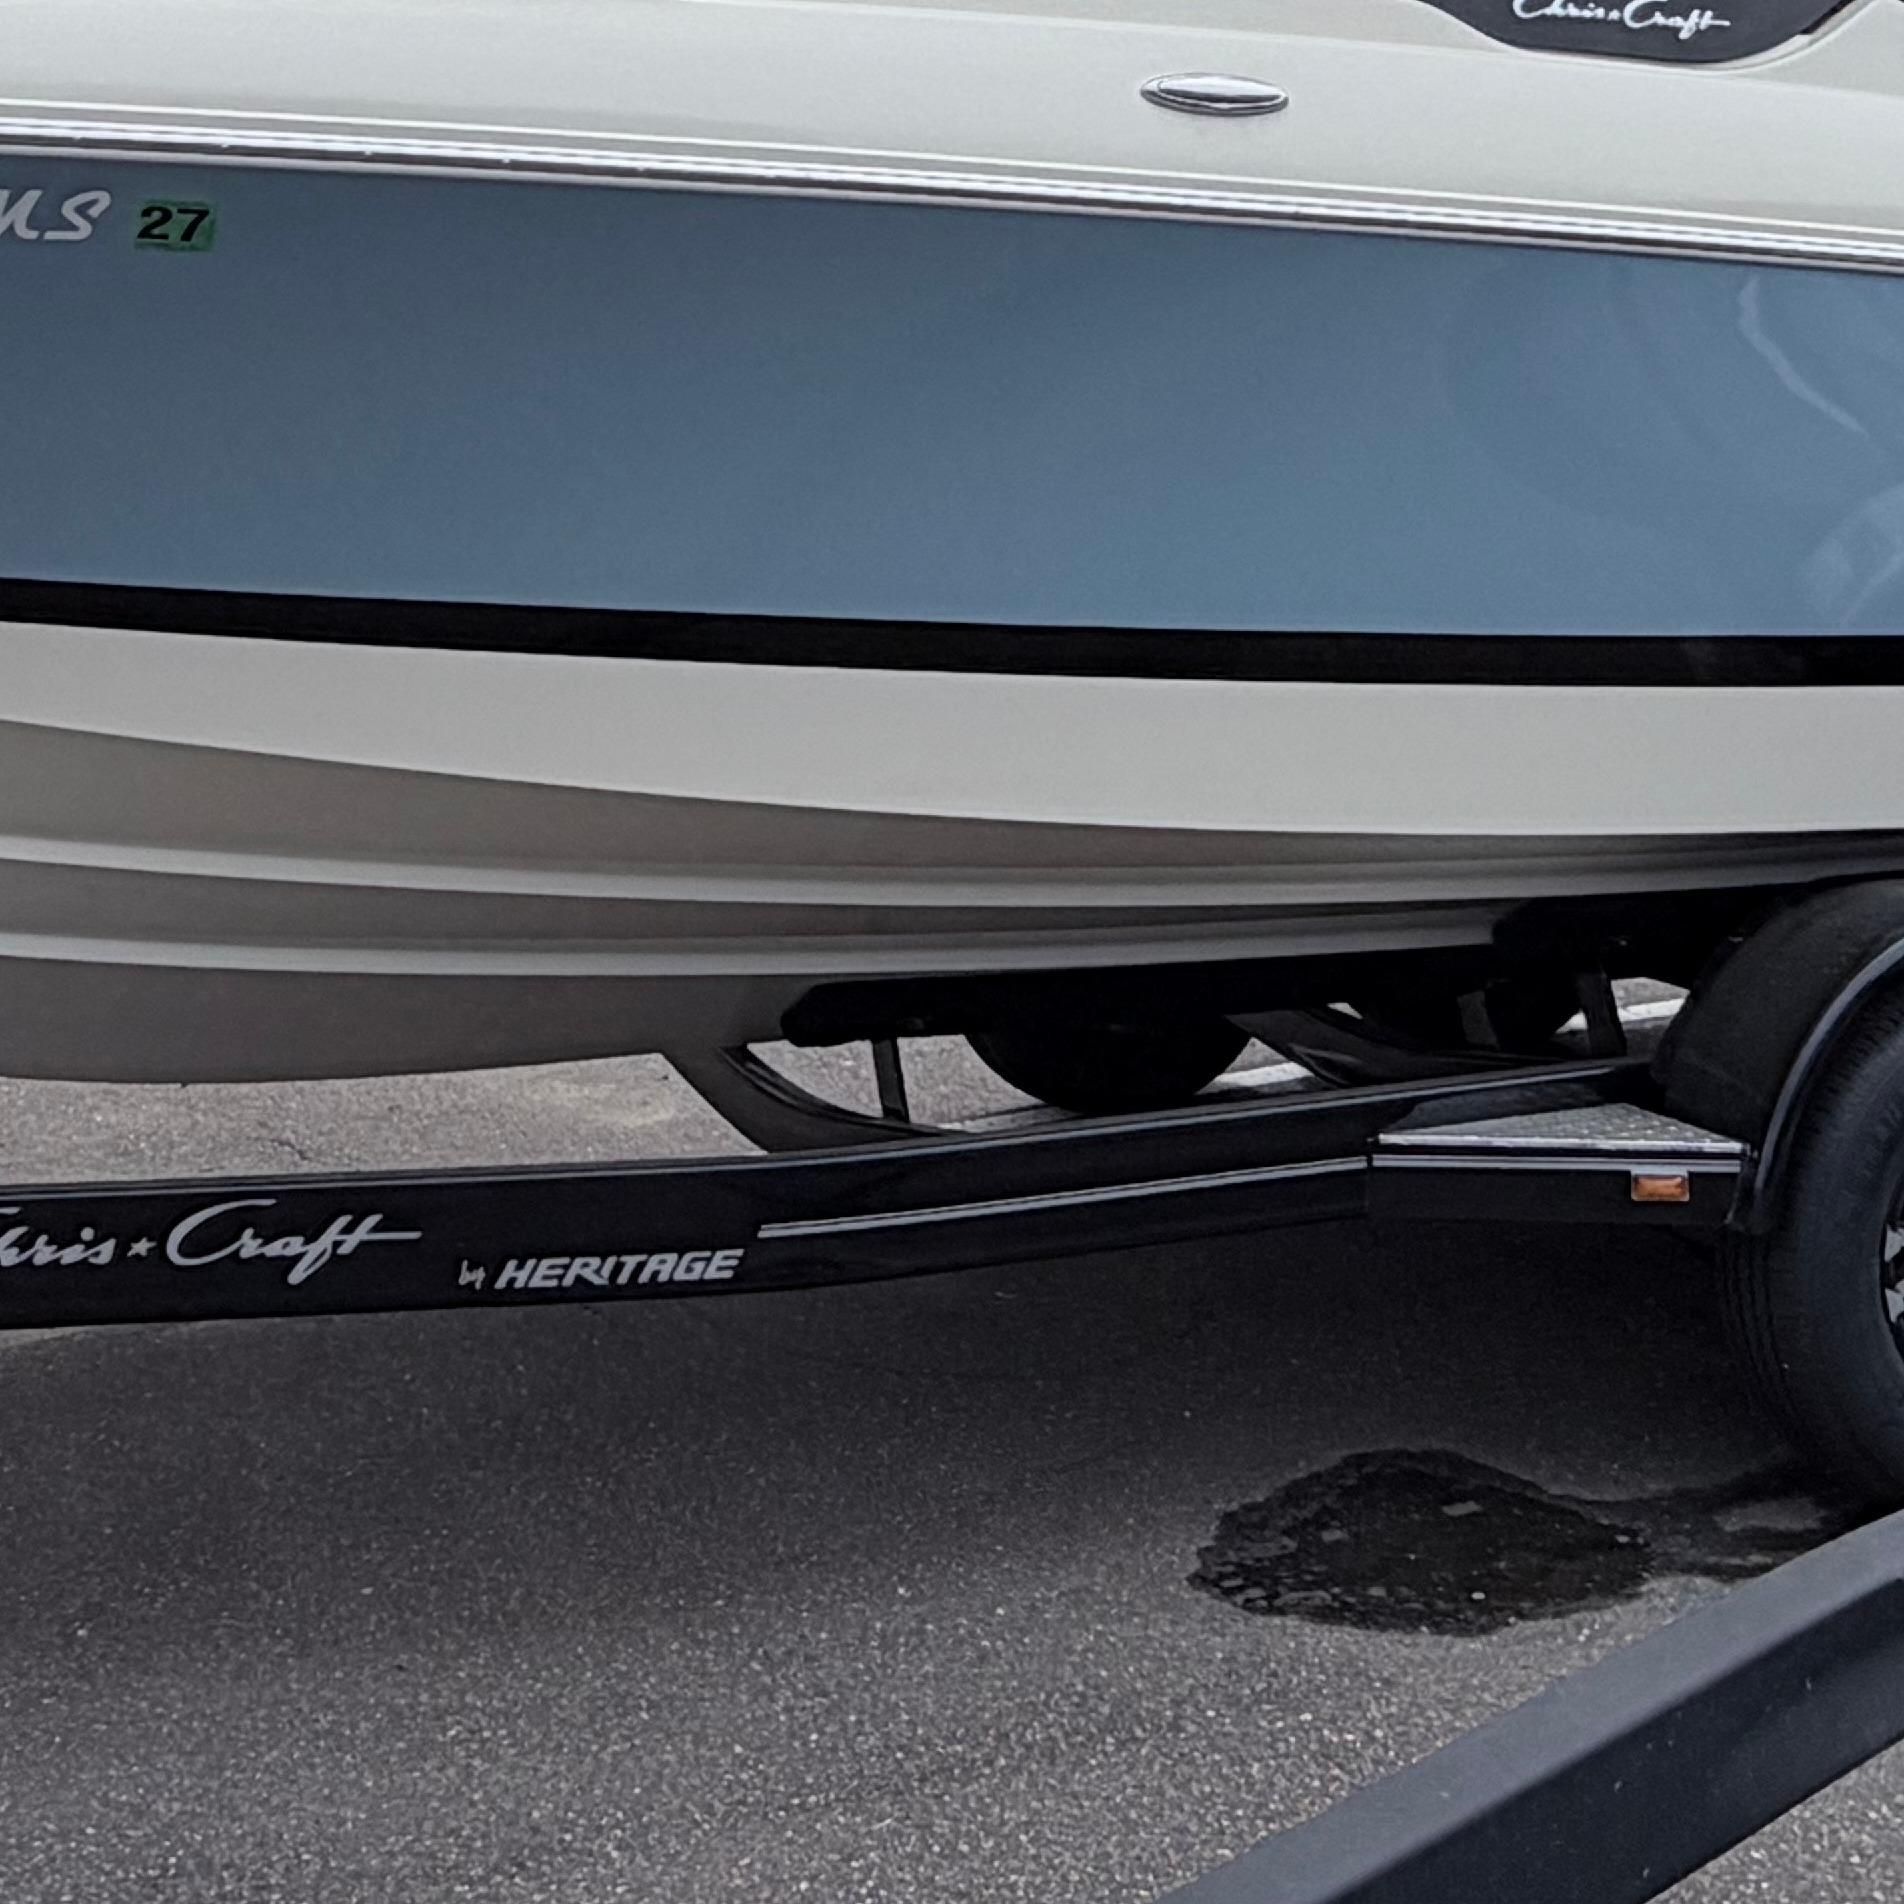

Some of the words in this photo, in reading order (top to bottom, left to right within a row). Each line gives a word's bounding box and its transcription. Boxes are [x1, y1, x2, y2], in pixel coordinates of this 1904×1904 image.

[137, 206, 210, 242] 27
[165, 1198, 423, 1286] Craft
[458, 1259, 486, 1290] by
[494, 1248, 745, 1290] HERITAGE
